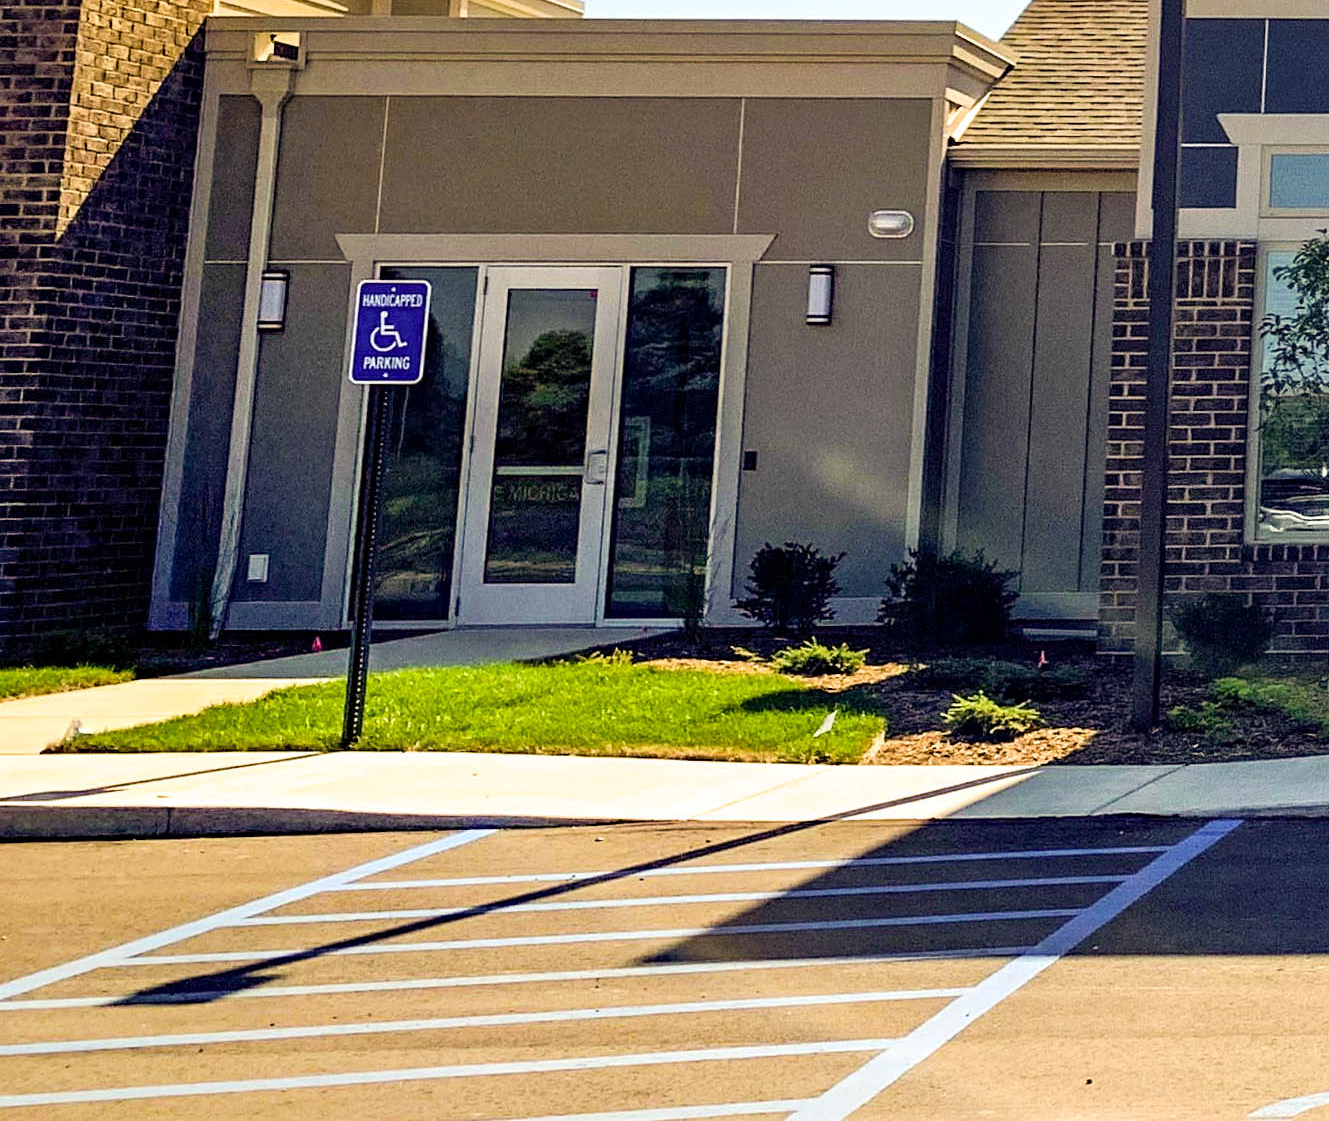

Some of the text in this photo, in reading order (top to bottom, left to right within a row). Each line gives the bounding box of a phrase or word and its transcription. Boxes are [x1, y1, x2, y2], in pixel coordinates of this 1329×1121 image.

[362, 293, 424, 308] HANDICAPPED
[362, 356, 411, 371] PARKING
[508, 484, 580, 502] MICHIGA
